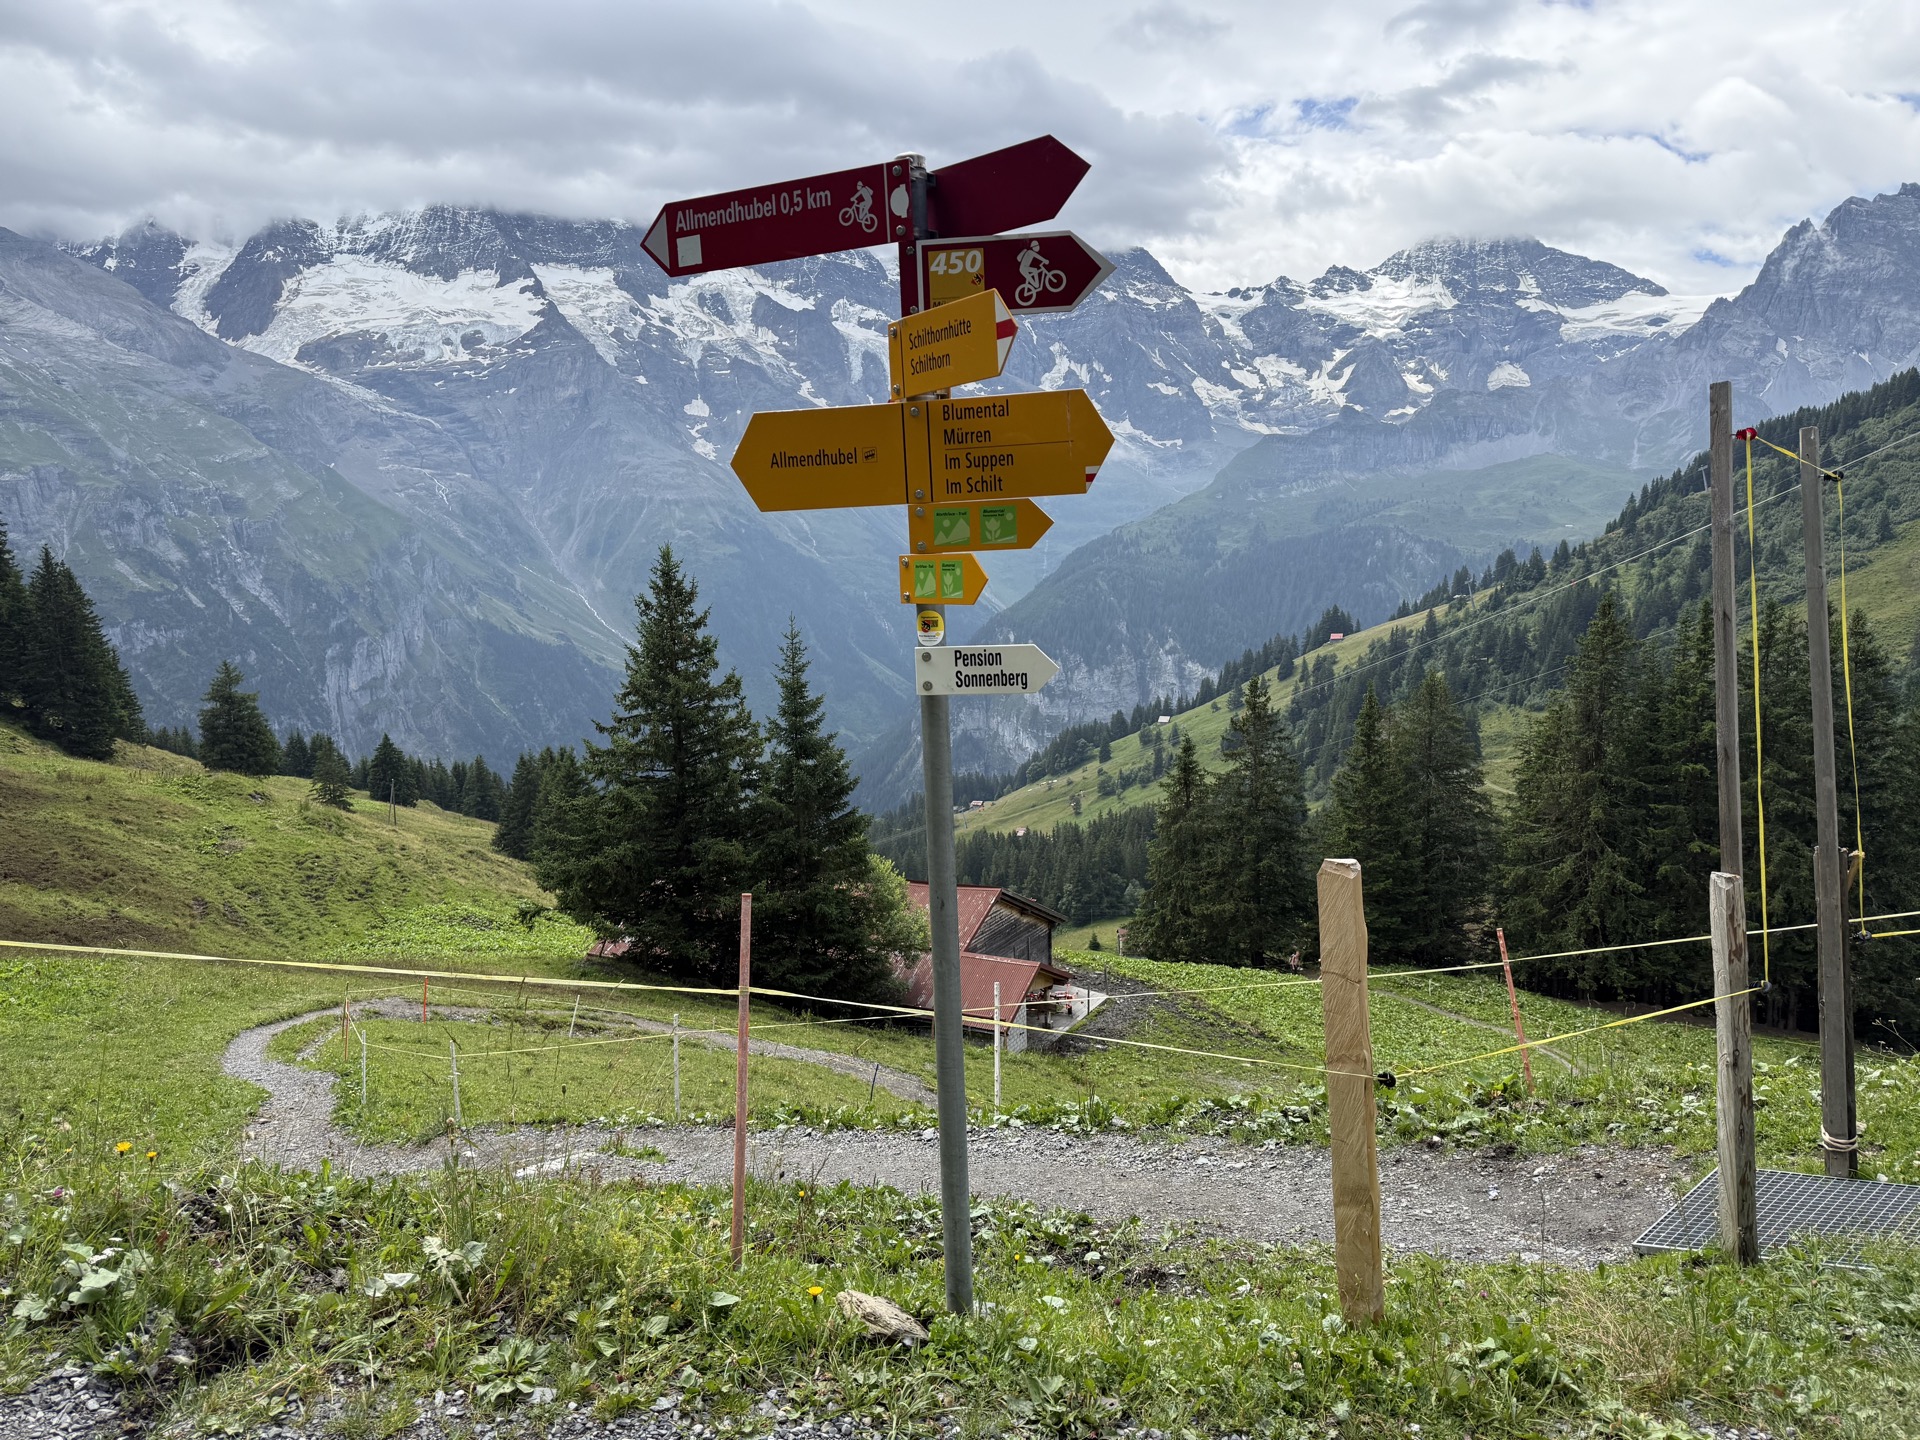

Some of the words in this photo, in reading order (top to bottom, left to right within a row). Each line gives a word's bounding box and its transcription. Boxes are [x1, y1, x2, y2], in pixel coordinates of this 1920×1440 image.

[675, 194, 777, 232] Allmendhubel
[780, 190, 802, 216] 0,5
[807, 187, 831, 209] km
[930, 250, 982, 275] 450
[909, 318, 971, 350] Schilthornhütte
[911, 352, 951, 375] Schilthorn
[942, 399, 1009, 421] Blumental
[943, 427, 991, 445] Mürren
[770, 447, 858, 469] Allmendhubel
[945, 453, 961, 470] Im
[965, 452, 1014, 472] Suppen
[946, 478, 962, 494] Im
[966, 474, 1003, 493] Schilt
[954, 649, 1002, 667] Pension
[955, 670, 1028, 689] Sonnenberg
